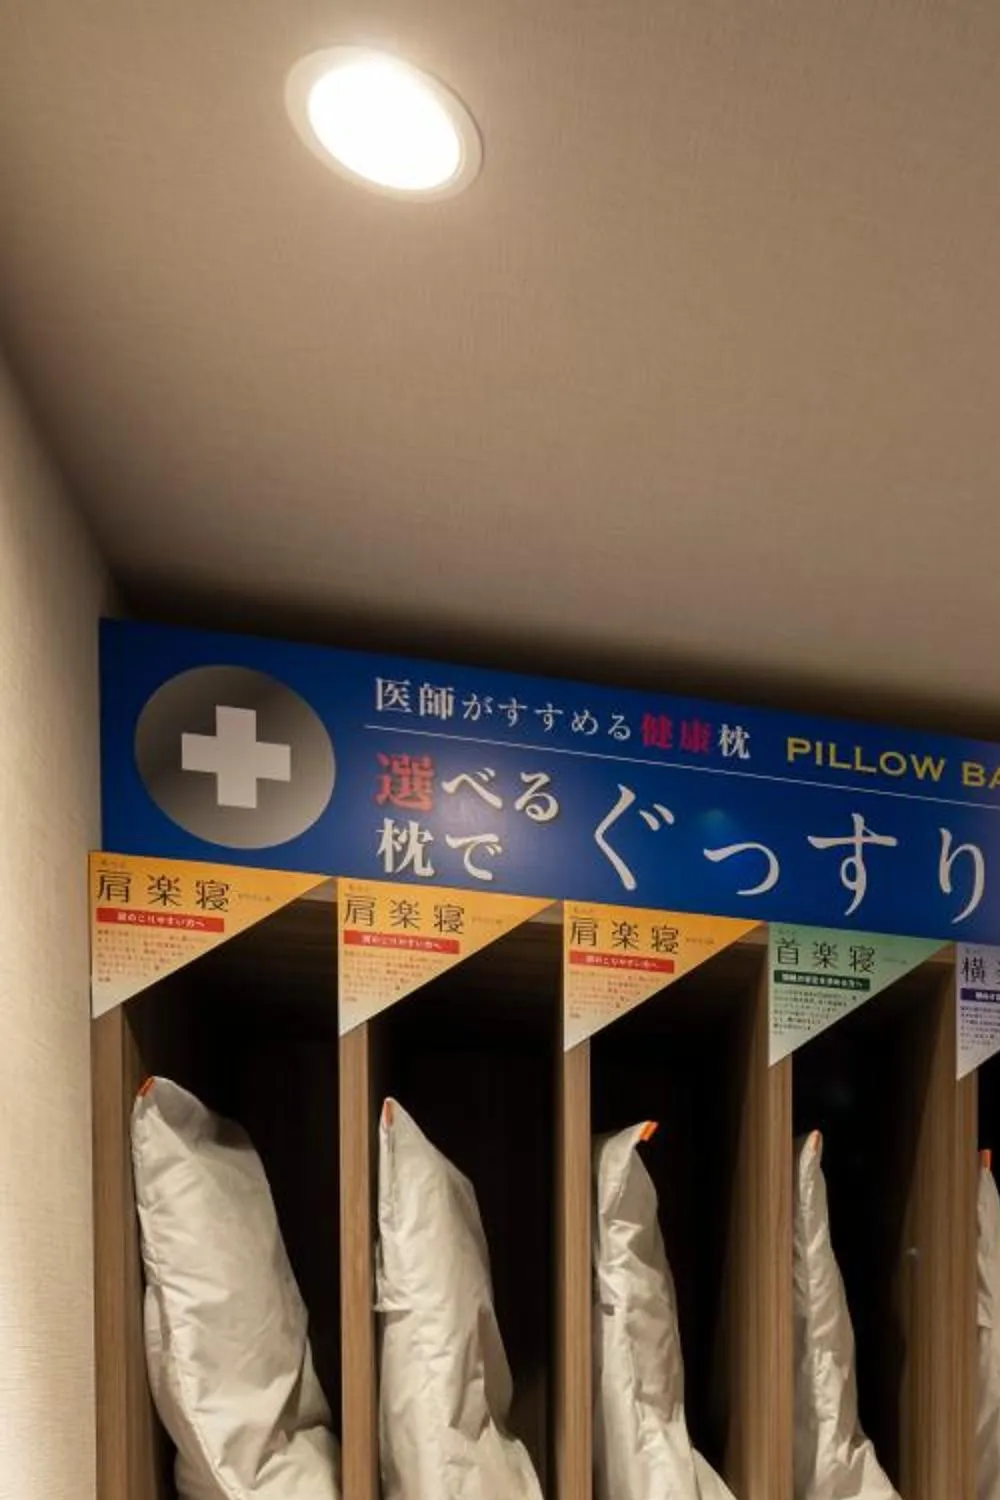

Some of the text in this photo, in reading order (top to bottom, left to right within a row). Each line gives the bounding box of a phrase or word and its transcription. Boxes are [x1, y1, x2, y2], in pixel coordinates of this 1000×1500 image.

[375, 676, 752, 760] 医師がすすめる健康枕
[786, 736, 947, 783] PILLOW
[375, 752, 560, 822] 選べる
[376, 817, 503, 881] 枕で
[96, 869, 233, 913] 肩楽寝
[344, 893, 465, 935] 肩楽寝
[570, 916, 680, 955] 肩楽寝
[775, 937, 877, 974] 首楽寝
